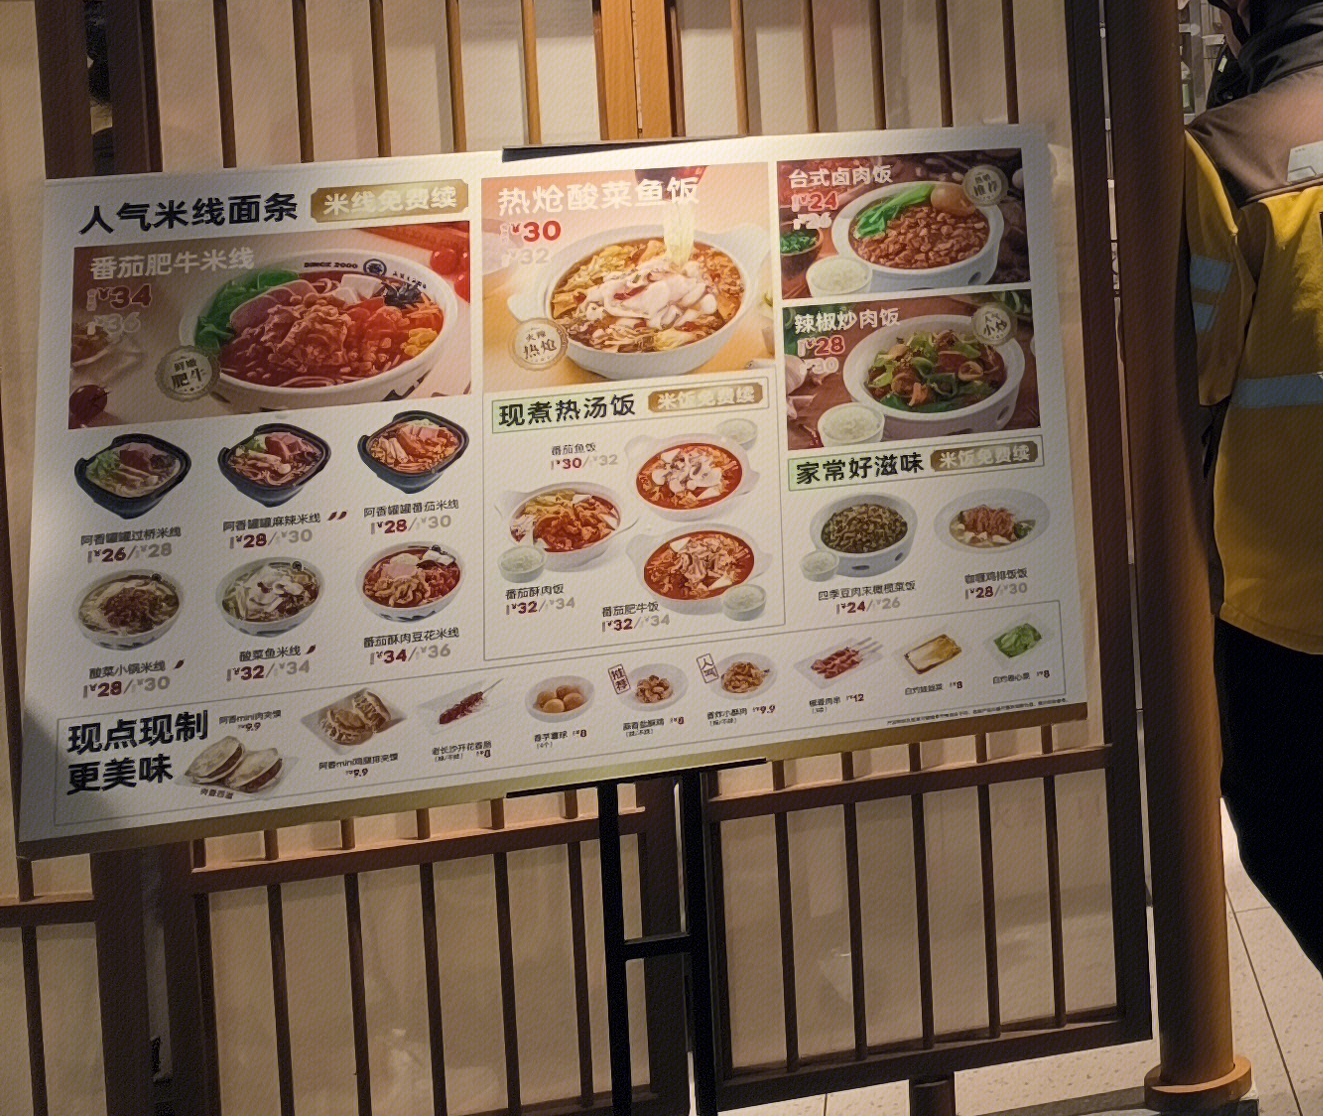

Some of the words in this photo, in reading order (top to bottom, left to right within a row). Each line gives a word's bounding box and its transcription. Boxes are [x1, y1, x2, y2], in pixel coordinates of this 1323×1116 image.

[788, 164, 894, 189] 台式卤肉饭
[79, 192, 299, 235] 人气米线面条
[322, 186, 458, 216] 米线免费续
[497, 176, 701, 217] 热炝酸菜鱼饭
[90, 246, 255, 281] 番茄肥牛米线
[794, 307, 901, 334] 辣椒炒肉饭
[498, 392, 636, 427] 现煮热汤饭
[796, 451, 924, 485] 家常好滋味
[67, 709, 209, 756] 现点现制
[66, 753, 174, 795] 更美味
